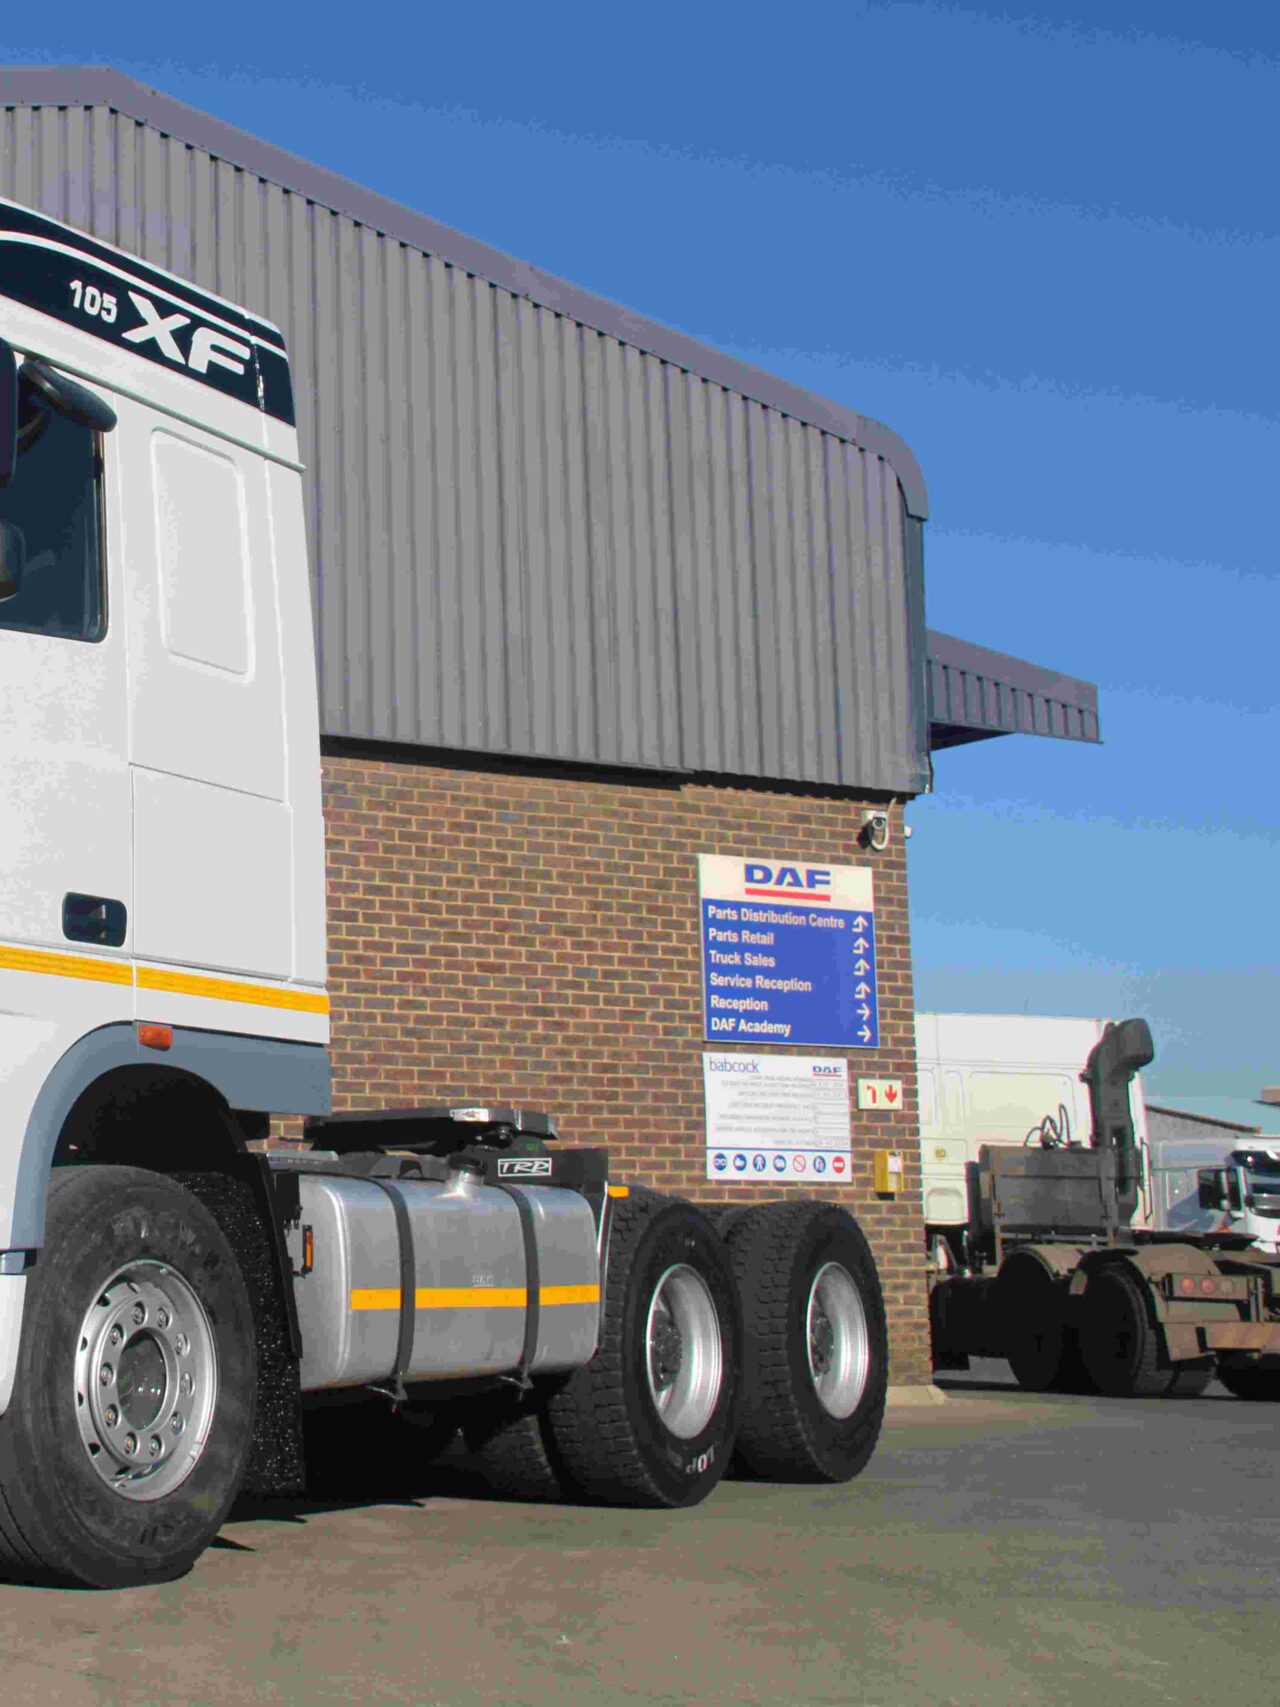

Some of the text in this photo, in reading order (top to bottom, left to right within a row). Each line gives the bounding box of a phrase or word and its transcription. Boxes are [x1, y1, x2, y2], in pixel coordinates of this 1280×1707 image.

[69, 279, 251, 375] 105 XF
[744, 863, 831, 889] DAF
[708, 906, 845, 929] Parts Distribution Centre
[709, 929, 774, 945] Parts Retail
[709, 951, 776, 968] Truck Sales
[710, 973, 812, 992] Service Reception
[711, 995, 768, 1012] Reception
[712, 1018, 791, 1037] DAF Academy
[709, 1057, 843, 1074] babcock DAF
[500, 1162, 549, 1173] TRP
